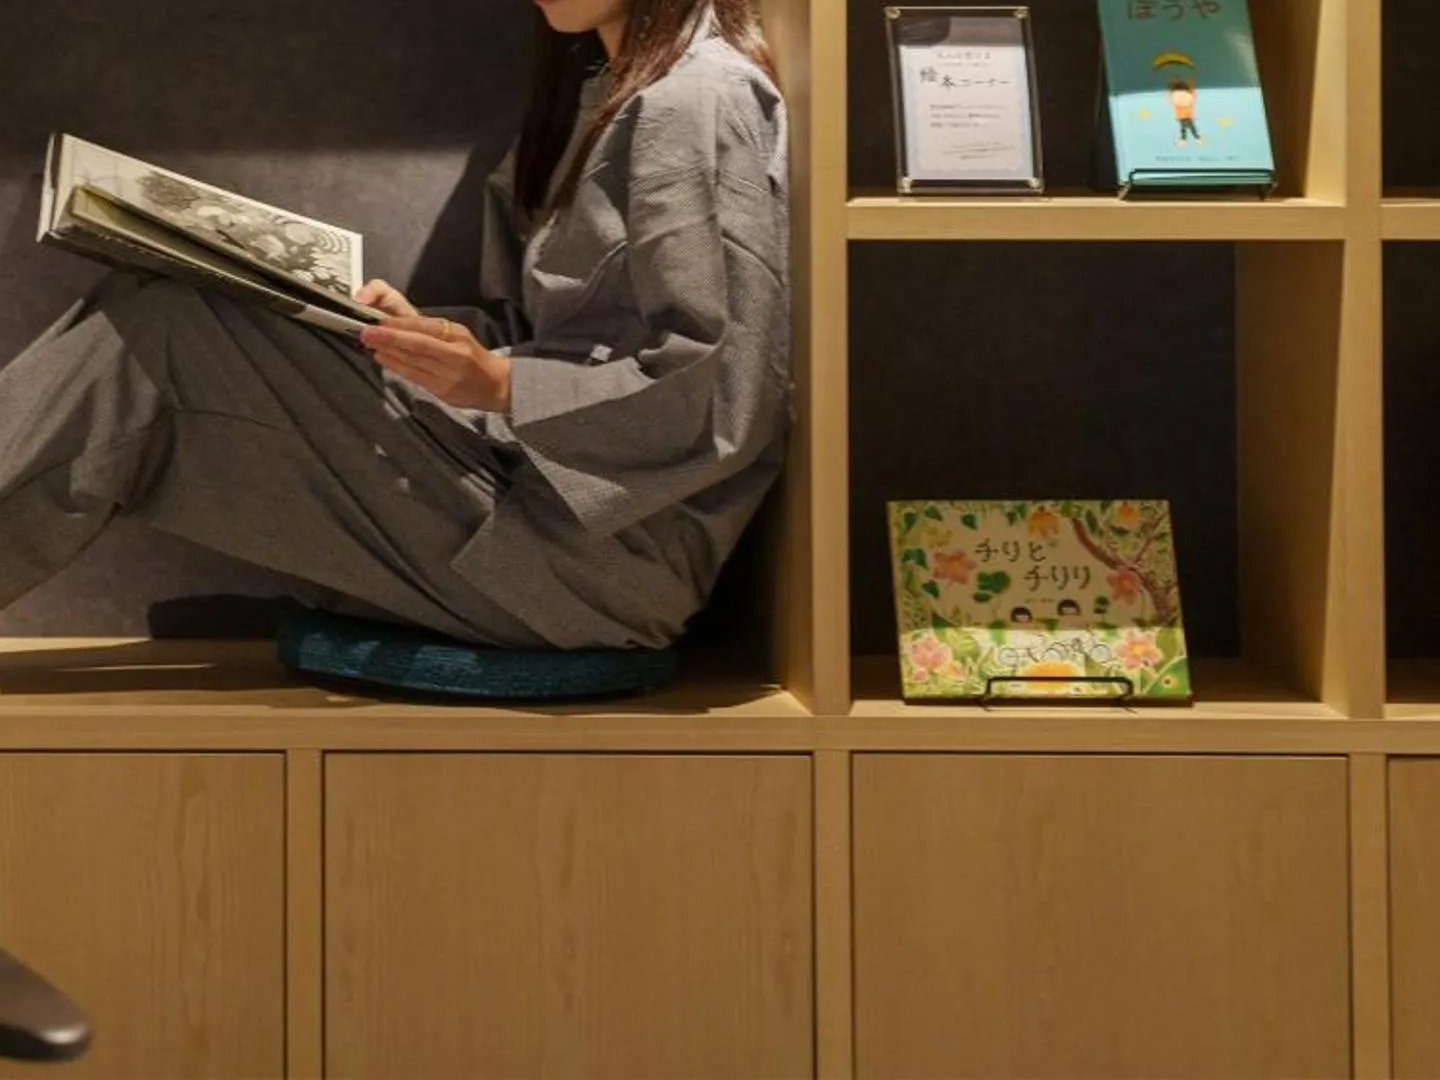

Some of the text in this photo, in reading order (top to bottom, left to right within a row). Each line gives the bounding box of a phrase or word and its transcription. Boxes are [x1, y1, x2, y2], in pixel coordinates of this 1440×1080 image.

[975, 537, 1047, 563] チリと
[1023, 564, 1092, 592] チリリ
